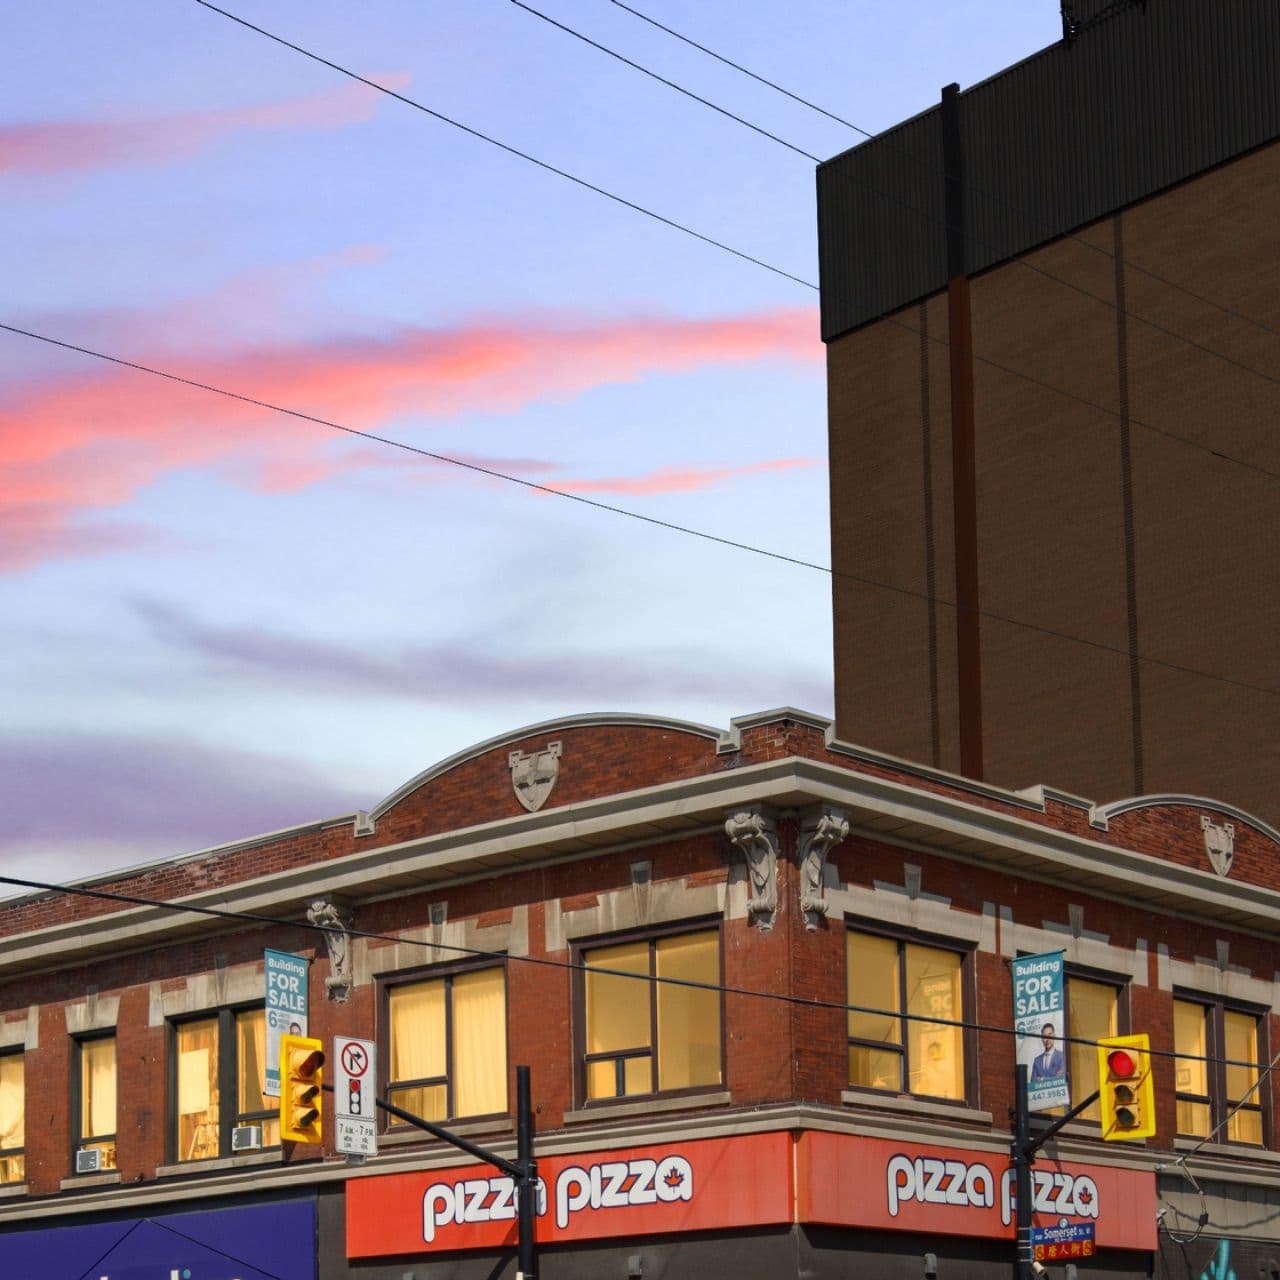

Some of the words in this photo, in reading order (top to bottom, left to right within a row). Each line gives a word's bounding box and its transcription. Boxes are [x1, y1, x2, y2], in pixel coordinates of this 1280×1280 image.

[268, 958, 305, 977] Building
[1016, 961, 1060, 976] Building
[268, 971, 299, 993] FOR
[1016, 975, 1052, 998] FOR
[268, 990, 305, 1012] SALE
[1016, 992, 1060, 1016] SALE
[268, 1011, 277, 1028] 6
[1000, 1166, 1099, 1227] pzza
[1044, 1225, 1077, 1240] Somerset
